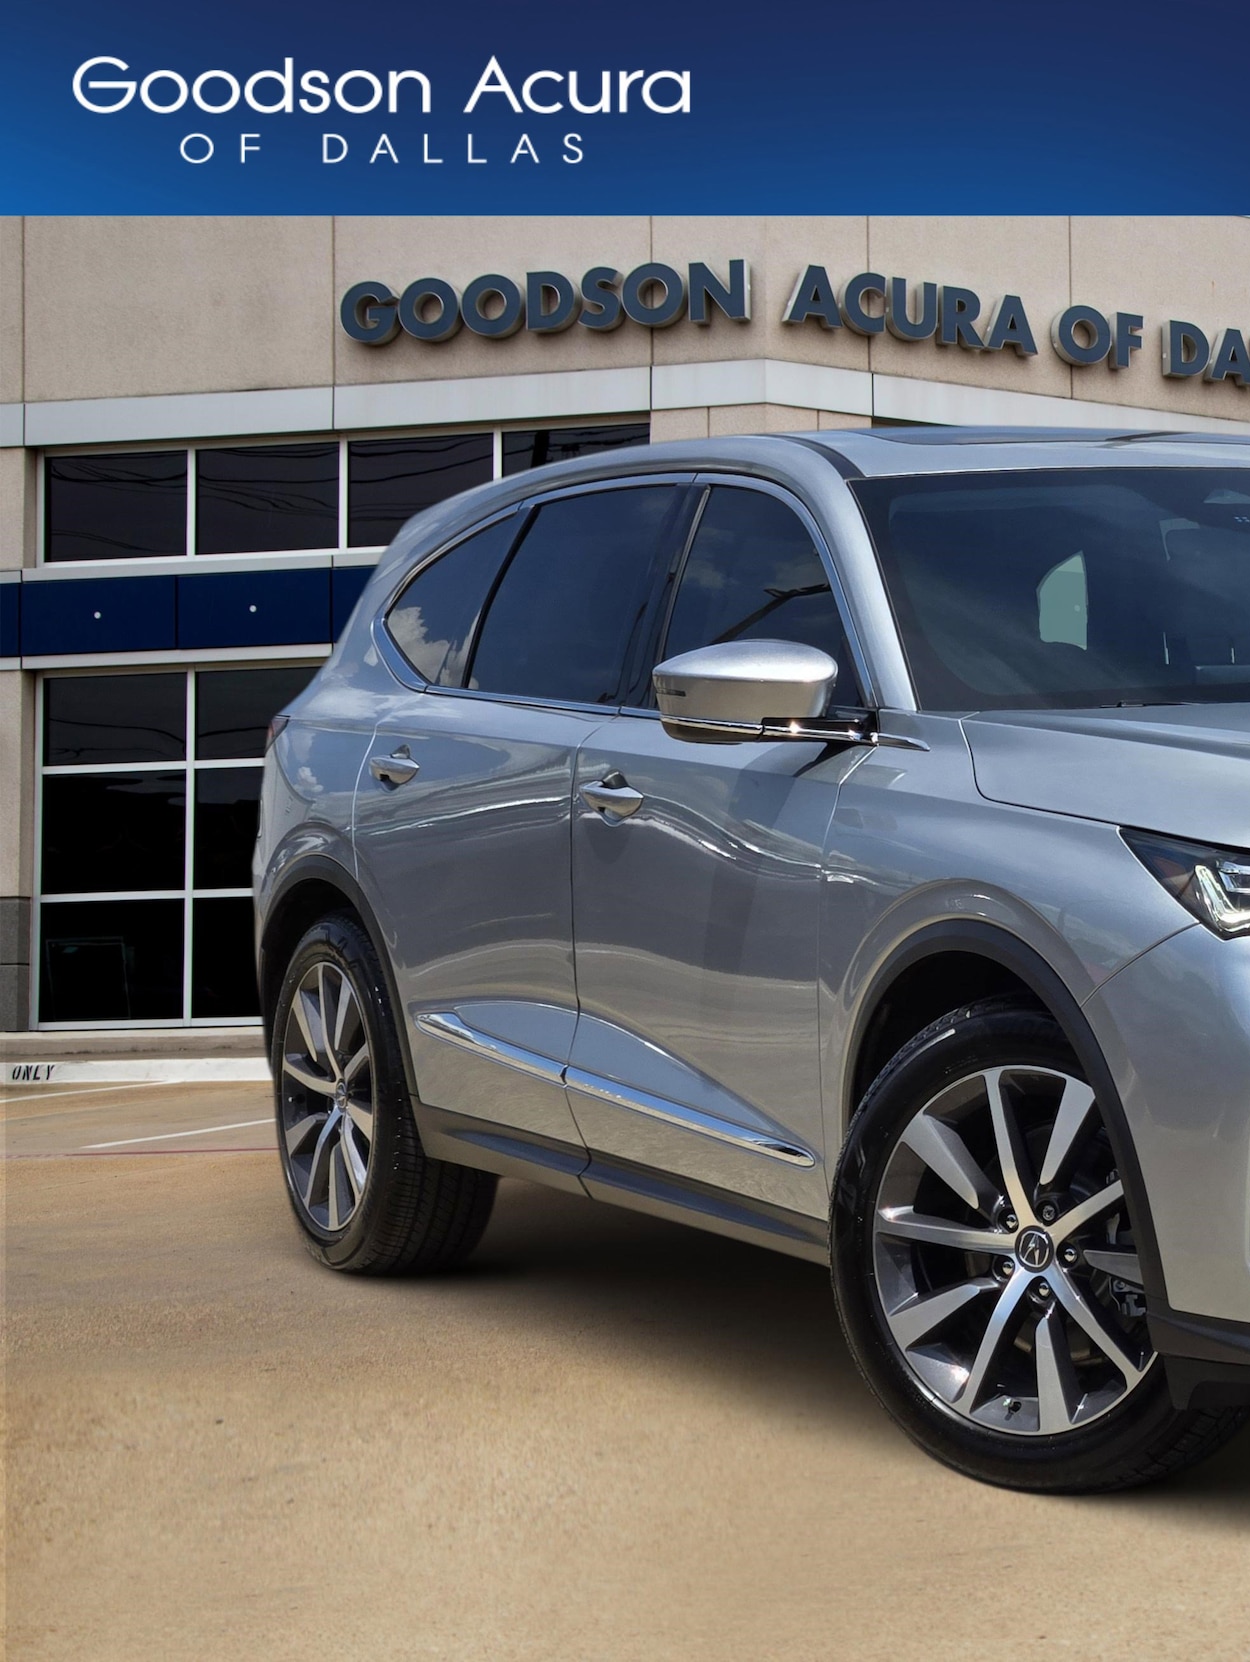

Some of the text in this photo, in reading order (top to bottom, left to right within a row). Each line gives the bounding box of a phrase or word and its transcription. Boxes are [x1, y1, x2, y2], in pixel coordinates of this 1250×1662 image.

[340, 258, 752, 346] GOODSON
[782, 264, 1038, 357] ACURA
[1051, 304, 1144, 370] OF
[12, 1064, 55, 1081] ONLY
